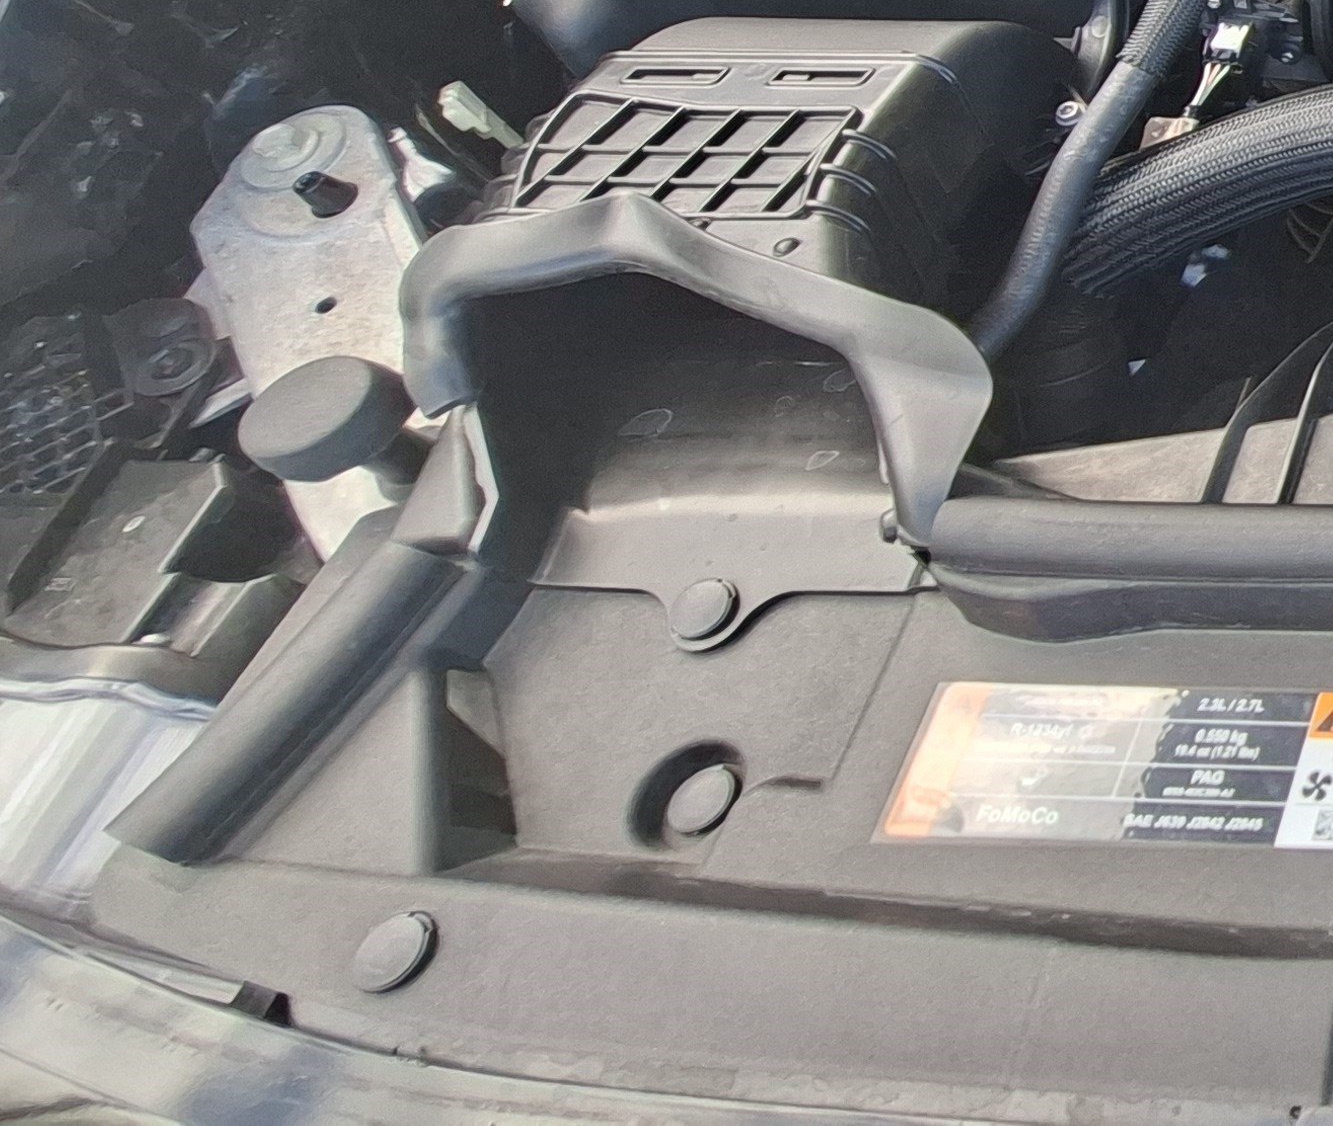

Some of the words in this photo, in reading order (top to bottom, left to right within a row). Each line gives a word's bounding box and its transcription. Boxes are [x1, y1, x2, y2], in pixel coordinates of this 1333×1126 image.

[1235, 698, 1265, 713] 2.7L
[1190, 769, 1226, 785] PAG
[976, 804, 1060, 825] FoMoCo
[1122, 813, 1154, 828] SAE
